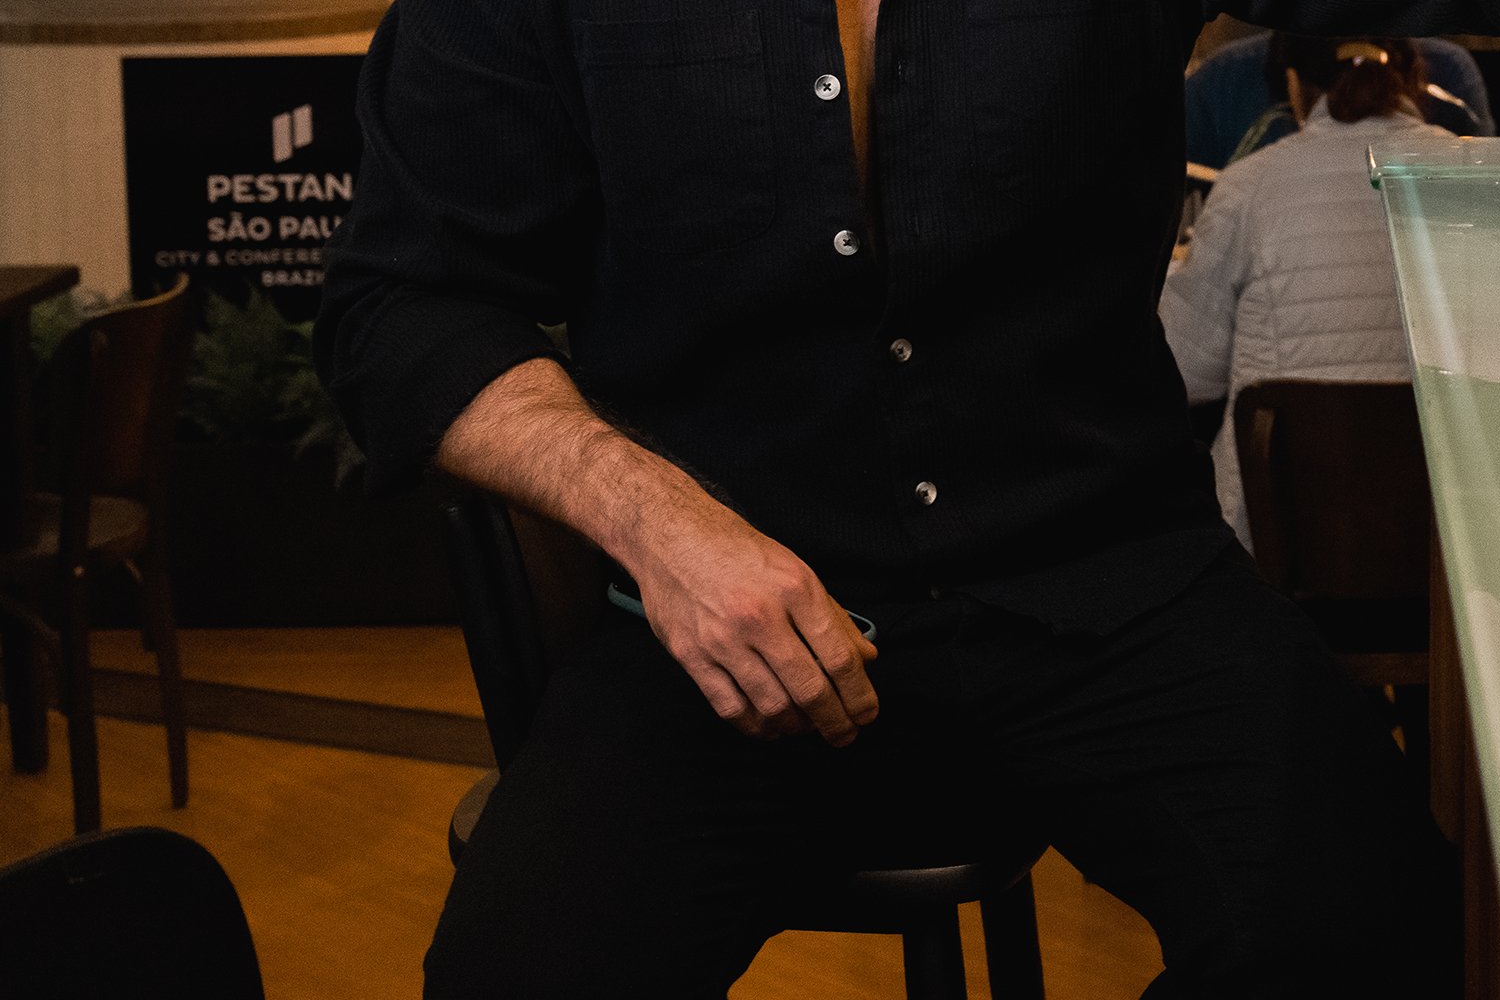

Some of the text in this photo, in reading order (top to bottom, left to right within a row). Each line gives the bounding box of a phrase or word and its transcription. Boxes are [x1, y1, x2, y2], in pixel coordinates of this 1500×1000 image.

[206, 174, 352, 202] PESTAN
[206, 211, 342, 241] SÃO PAU
[154, 249, 322, 267] CITY & CONFERE
